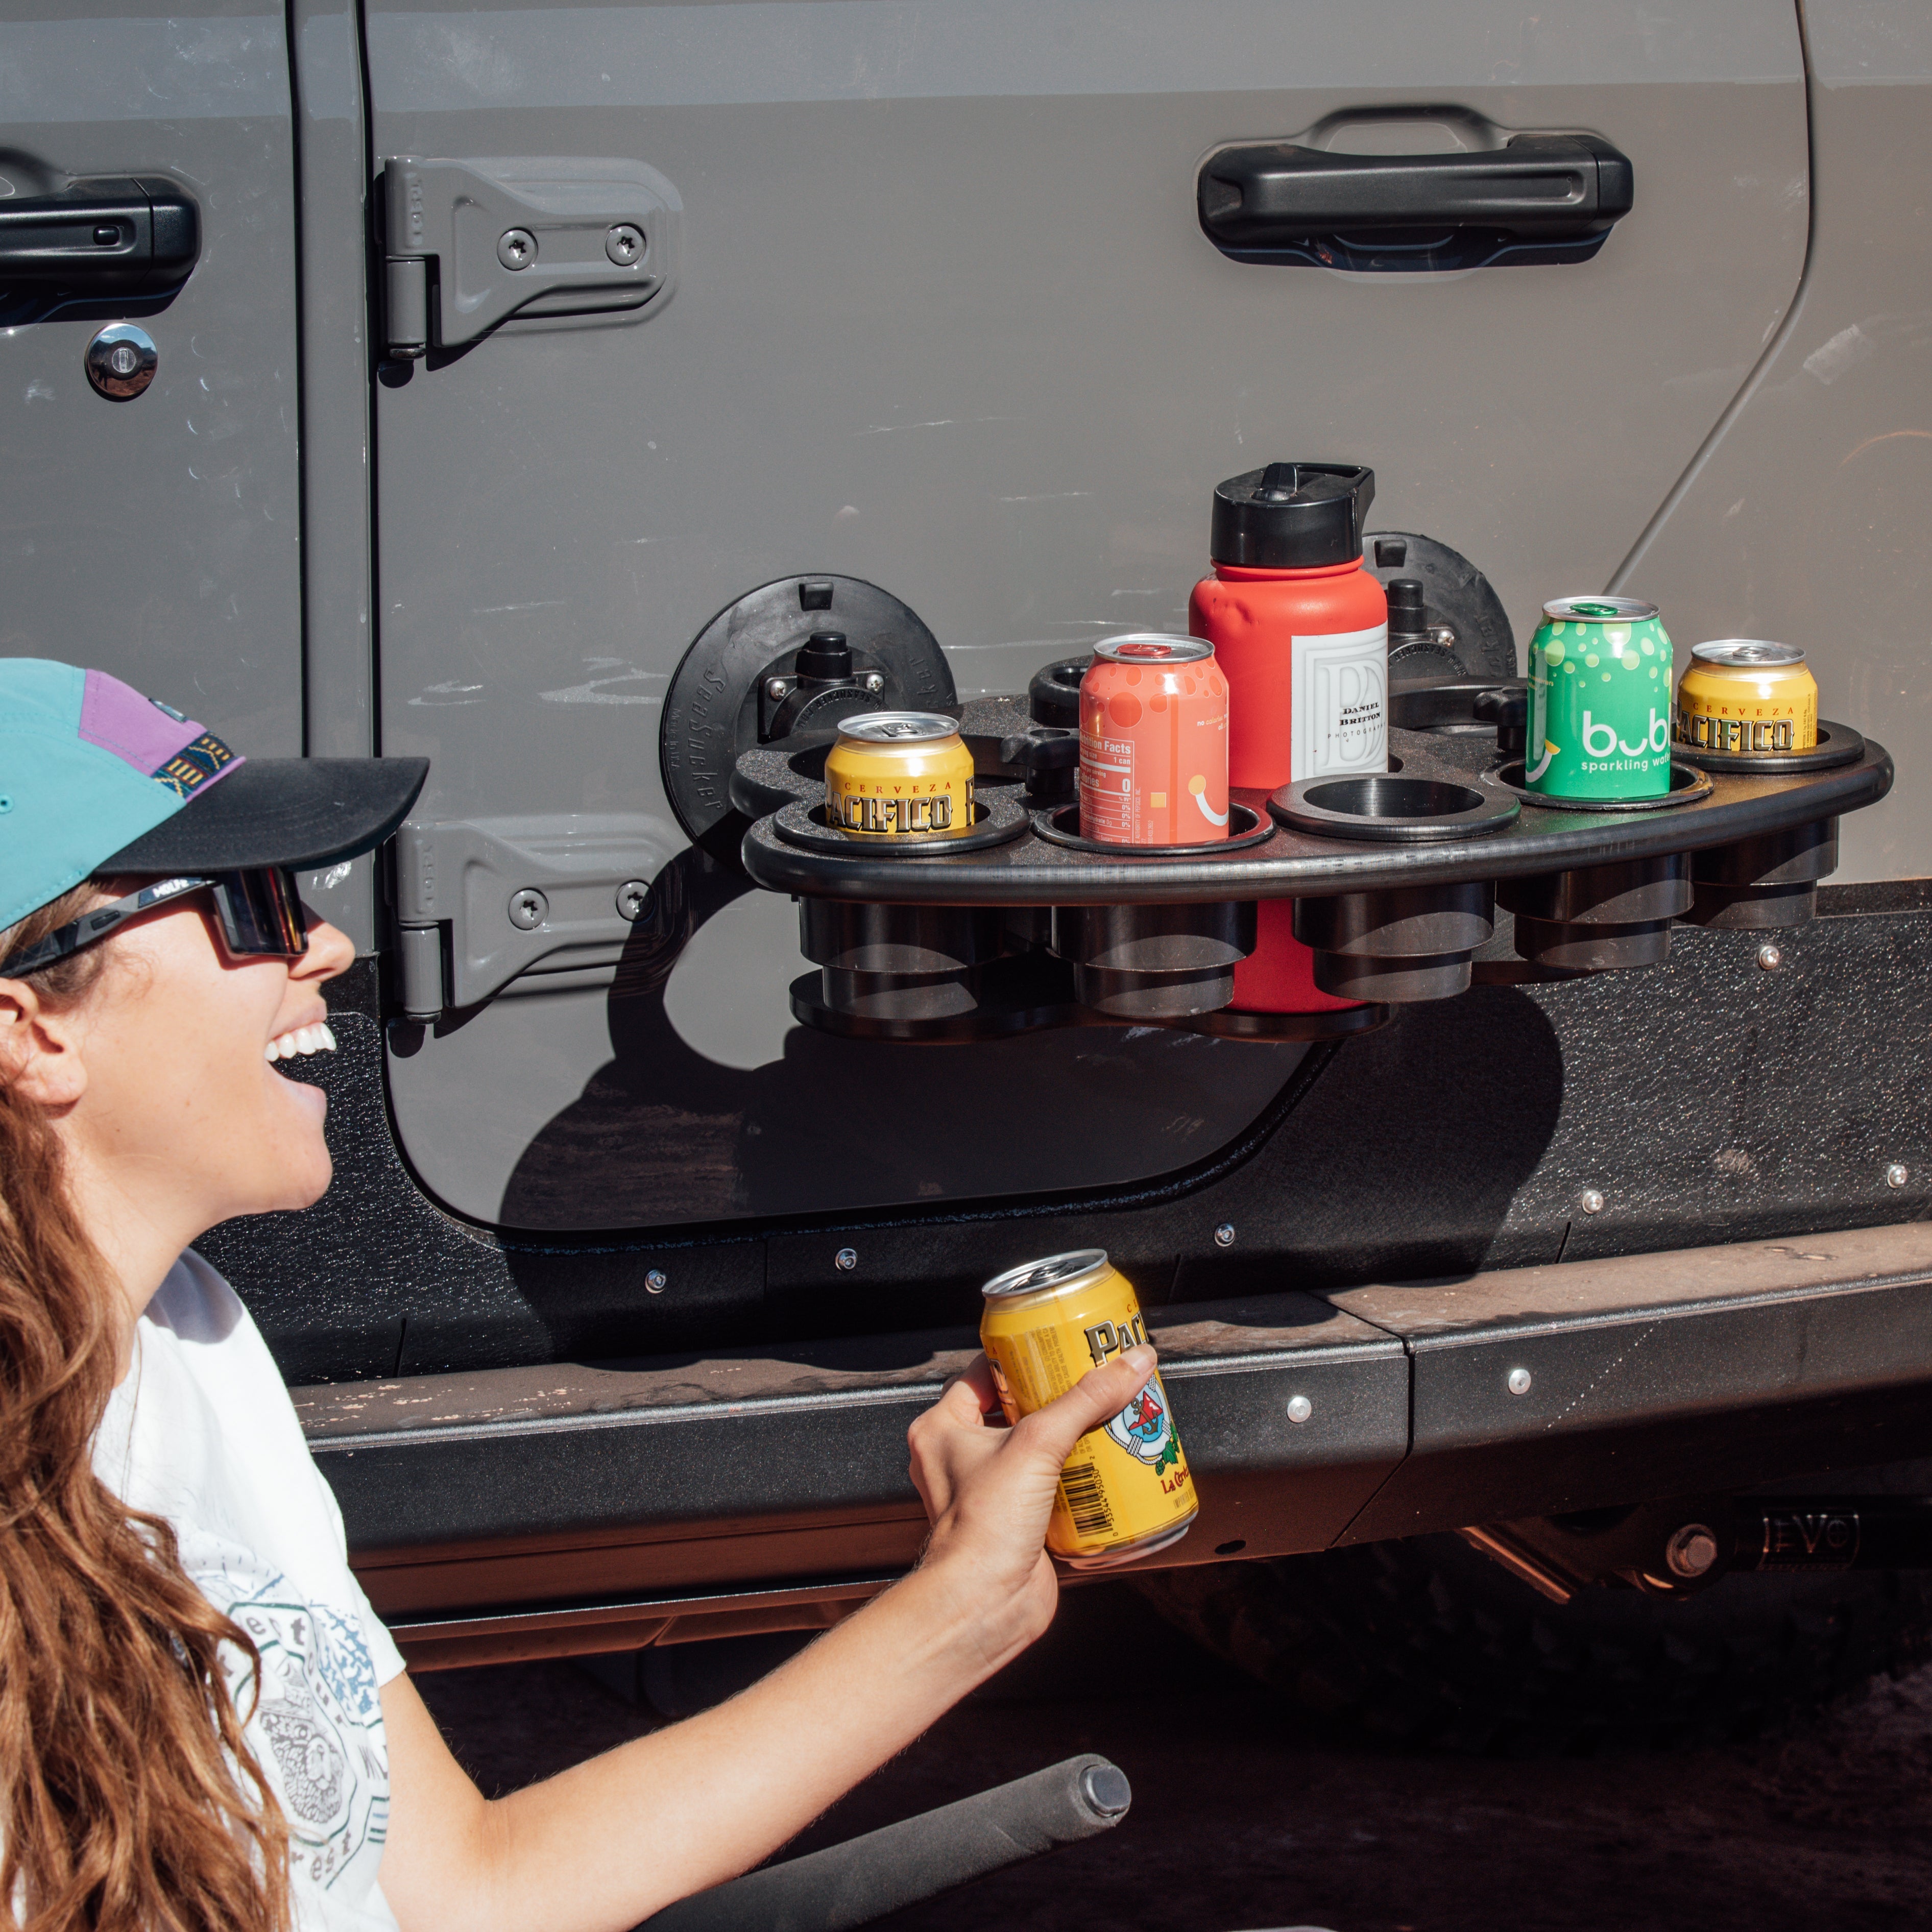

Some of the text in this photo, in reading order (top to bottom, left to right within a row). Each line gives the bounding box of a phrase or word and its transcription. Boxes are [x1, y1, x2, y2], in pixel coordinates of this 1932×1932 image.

[1342, 702, 1380, 715] DANIEL
[1693, 702, 1794, 716] CERVEZA
[1339, 712, 1381, 726] BRITTON
[1104, 740, 1131, 755] Facts
[1089, 752, 1098, 760] size
[1581, 752, 1671, 774] sparkling wate
[1092, 769, 1106, 778] serving
[845, 781, 951, 794] CERVEZA
[1122, 778, 1131, 792] 0
[1092, 1469, 1106, 1495] 95030
[1161, 1477, 1176, 1494] La
[1101, 1496, 1115, 1524] 33544
